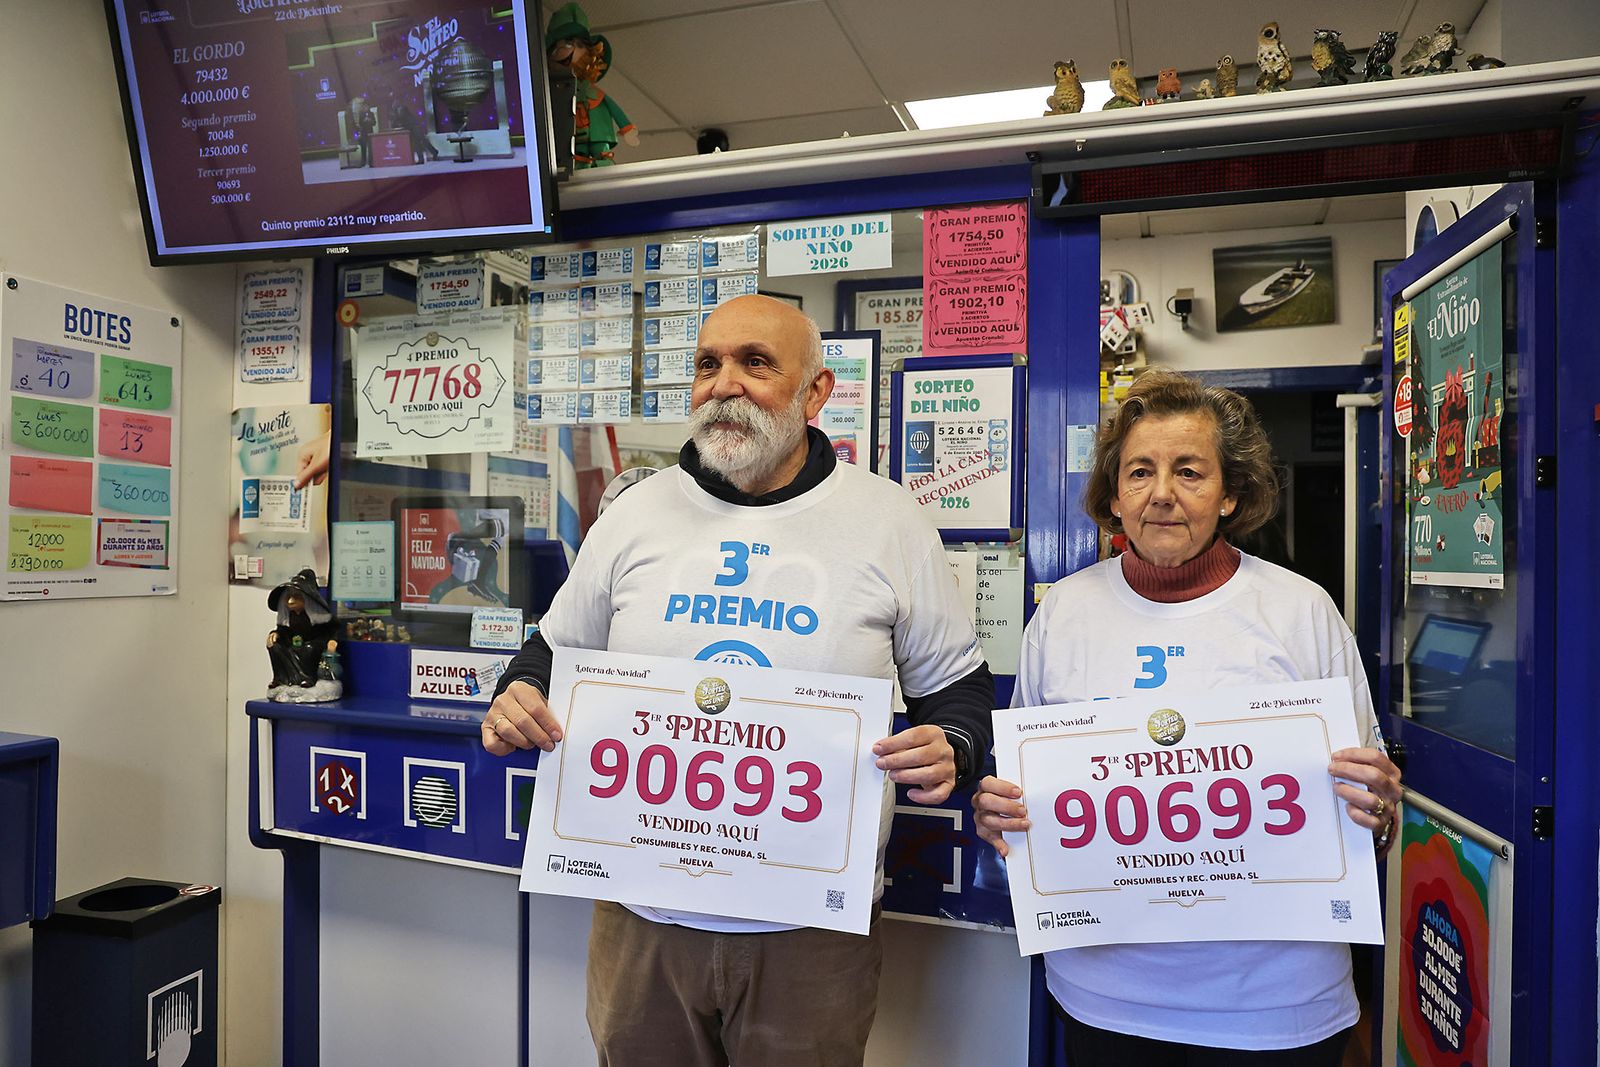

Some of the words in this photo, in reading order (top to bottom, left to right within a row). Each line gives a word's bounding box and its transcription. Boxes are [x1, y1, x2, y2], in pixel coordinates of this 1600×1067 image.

[173, 48, 189, 64] EL
[193, 41, 245, 61] GORDO
[196, 68, 229, 84] 79432
[181, 87, 239, 104] 4.000.000
[181, 117, 221, 132] Segundo
[222, 110, 257, 128] premio
[208, 130, 234, 141] 70048
[197, 168, 224, 178] Tercer
[225, 163, 257, 178] premio
[216, 180, 241, 190] 90693
[261, 219, 291, 231] Quinto
[293, 217, 325, 231] premio
[327, 214, 355, 227] 23112
[356, 214, 377, 226] muy
[379, 210, 426, 225] repartido.
[940, 217, 971, 227] GRAN
[974, 213, 1016, 225] PREMIO
[772, 224, 845, 243] SORTEO
[851, 221, 889, 236] DEL
[949, 229, 1005, 243] 1754,50
[326, 246, 350, 255] PHILIPS
[806, 238, 853, 256] NIÑO
[810, 257, 849, 271] 2026
[940, 258, 988, 268] VENDIDO
[424, 271, 446, 279] GRAN
[447, 268, 478, 277] PREMIO
[249, 279, 267, 288] GRAN
[269, 276, 297, 286] PREMIO
[430, 279, 470, 291] 1754,50
[939, 288, 970, 297] GRAN
[974, 284, 1016, 295] PREMIO
[423, 301, 456, 310] VENDIDO
[868, 297, 900, 309] GRAN
[950, 295, 1005, 309] 1902,10
[249, 311, 276, 320] VENDIDO
[1436, 294, 1480, 341] Niño
[64, 303, 132, 346] BOTES
[940, 325, 987, 336] VENDIDO
[247, 335, 265, 343] GRAN
[267, 334, 293, 342] PREMIO
[416, 349, 459, 362] PREMIO
[247, 369, 275, 377] VENDIDO
[384, 363, 483, 404] 77768
[914, 379, 975, 394] SORTEO
[1398, 381, 1412, 402] +18
[402, 403, 440, 413] VENDIDO
[911, 400, 939, 414] DEL
[942, 395, 981, 413] NIÑO
[237, 422, 256, 443] La
[258, 410, 291, 436] suerte
[120, 431, 143, 453] 13
[909, 471, 937, 491] HOY
[939, 463, 957, 483] LA
[958, 448, 994, 470] CASA
[916, 464, 1001, 507] RECOMIENDA
[940, 496, 971, 509] 2026
[1414, 514, 1432, 543] 770
[411, 540, 433, 554] FELIZ
[411, 556, 446, 571] NAVIDAD
[979, 580, 990, 588] de
[664, 594, 819, 636] PREMIO
[996, 619, 1008, 627] en
[416, 664, 478, 680] DECIMOS
[605, 667, 615, 676] de
[420, 682, 473, 697] AZULES
[794, 686, 804, 695] 22
[806, 688, 817, 697] de
[817, 689, 864, 701] Diciembre
[1249, 701, 1260, 710] 22
[1261, 700, 1272, 709] de
[1272, 697, 1322, 708] Diciembre
[1048, 721, 1059, 729] de
[665, 714, 787, 752] PREMIO
[1125, 743, 1253, 778] PREMIO
[588, 737, 824, 823] 90693
[1054, 773, 1307, 850] 90693
[637, 814, 711, 837] VENDIDO
[716, 823, 760, 843] AQUÍ
[630, 836, 692, 853] CONSUMIBLES
[700, 845, 720, 855] REC.
[721, 847, 755, 860] ONUBA,
[757, 852, 767, 860] SL
[679, 857, 714, 869] HUELVA
[1116, 851, 1195, 869] VENDIDO
[1199, 844, 1245, 867] AQUÍ
[567, 859, 603, 871] LOTERÍA
[566, 867, 611, 879] NACIONAL
[1113, 876, 1177, 887] CONSUMIBLES
[1186, 874, 1207, 883] REC.
[1209, 872, 1247, 882] ONUBA,
[1248, 872, 1259, 880] SL
[1168, 889, 1205, 898] HUELVA
[1056, 909, 1091, 920] LOTERÍA
[1057, 917, 1101, 927] NACIONAL
[1425, 906, 1459, 948] AHORA
[1425, 950, 1438, 980] AL
[1438, 961, 1458, 997] MES
[1420, 968, 1462, 1028] DURANTE
[1421, 995, 1434, 1025] 30
[1433, 1004, 1460, 1051] AÑOS
